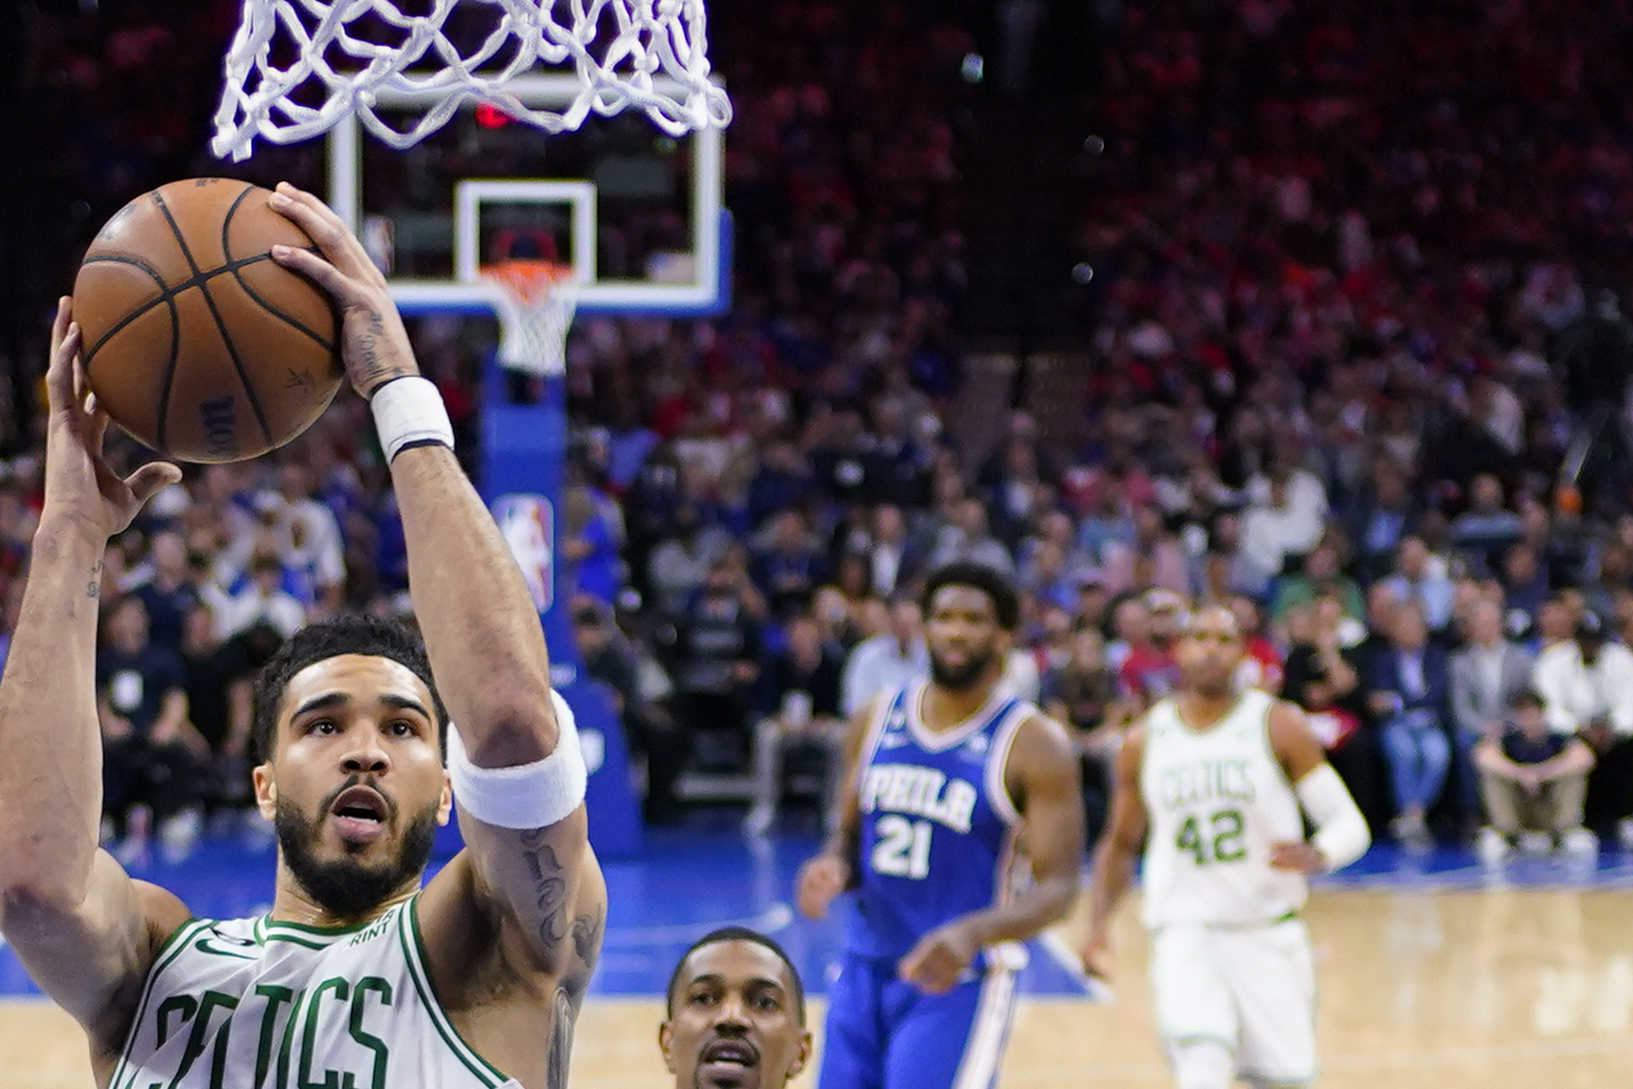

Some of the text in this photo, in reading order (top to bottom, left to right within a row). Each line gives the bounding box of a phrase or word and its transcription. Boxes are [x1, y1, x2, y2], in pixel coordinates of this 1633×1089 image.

[861, 763, 977, 834] PHILA
[1162, 759, 1254, 808] CELTICS
[872, 813, 933, 880] 21
[1176, 810, 1246, 865] 42
[349, 920, 391, 947] RINT
